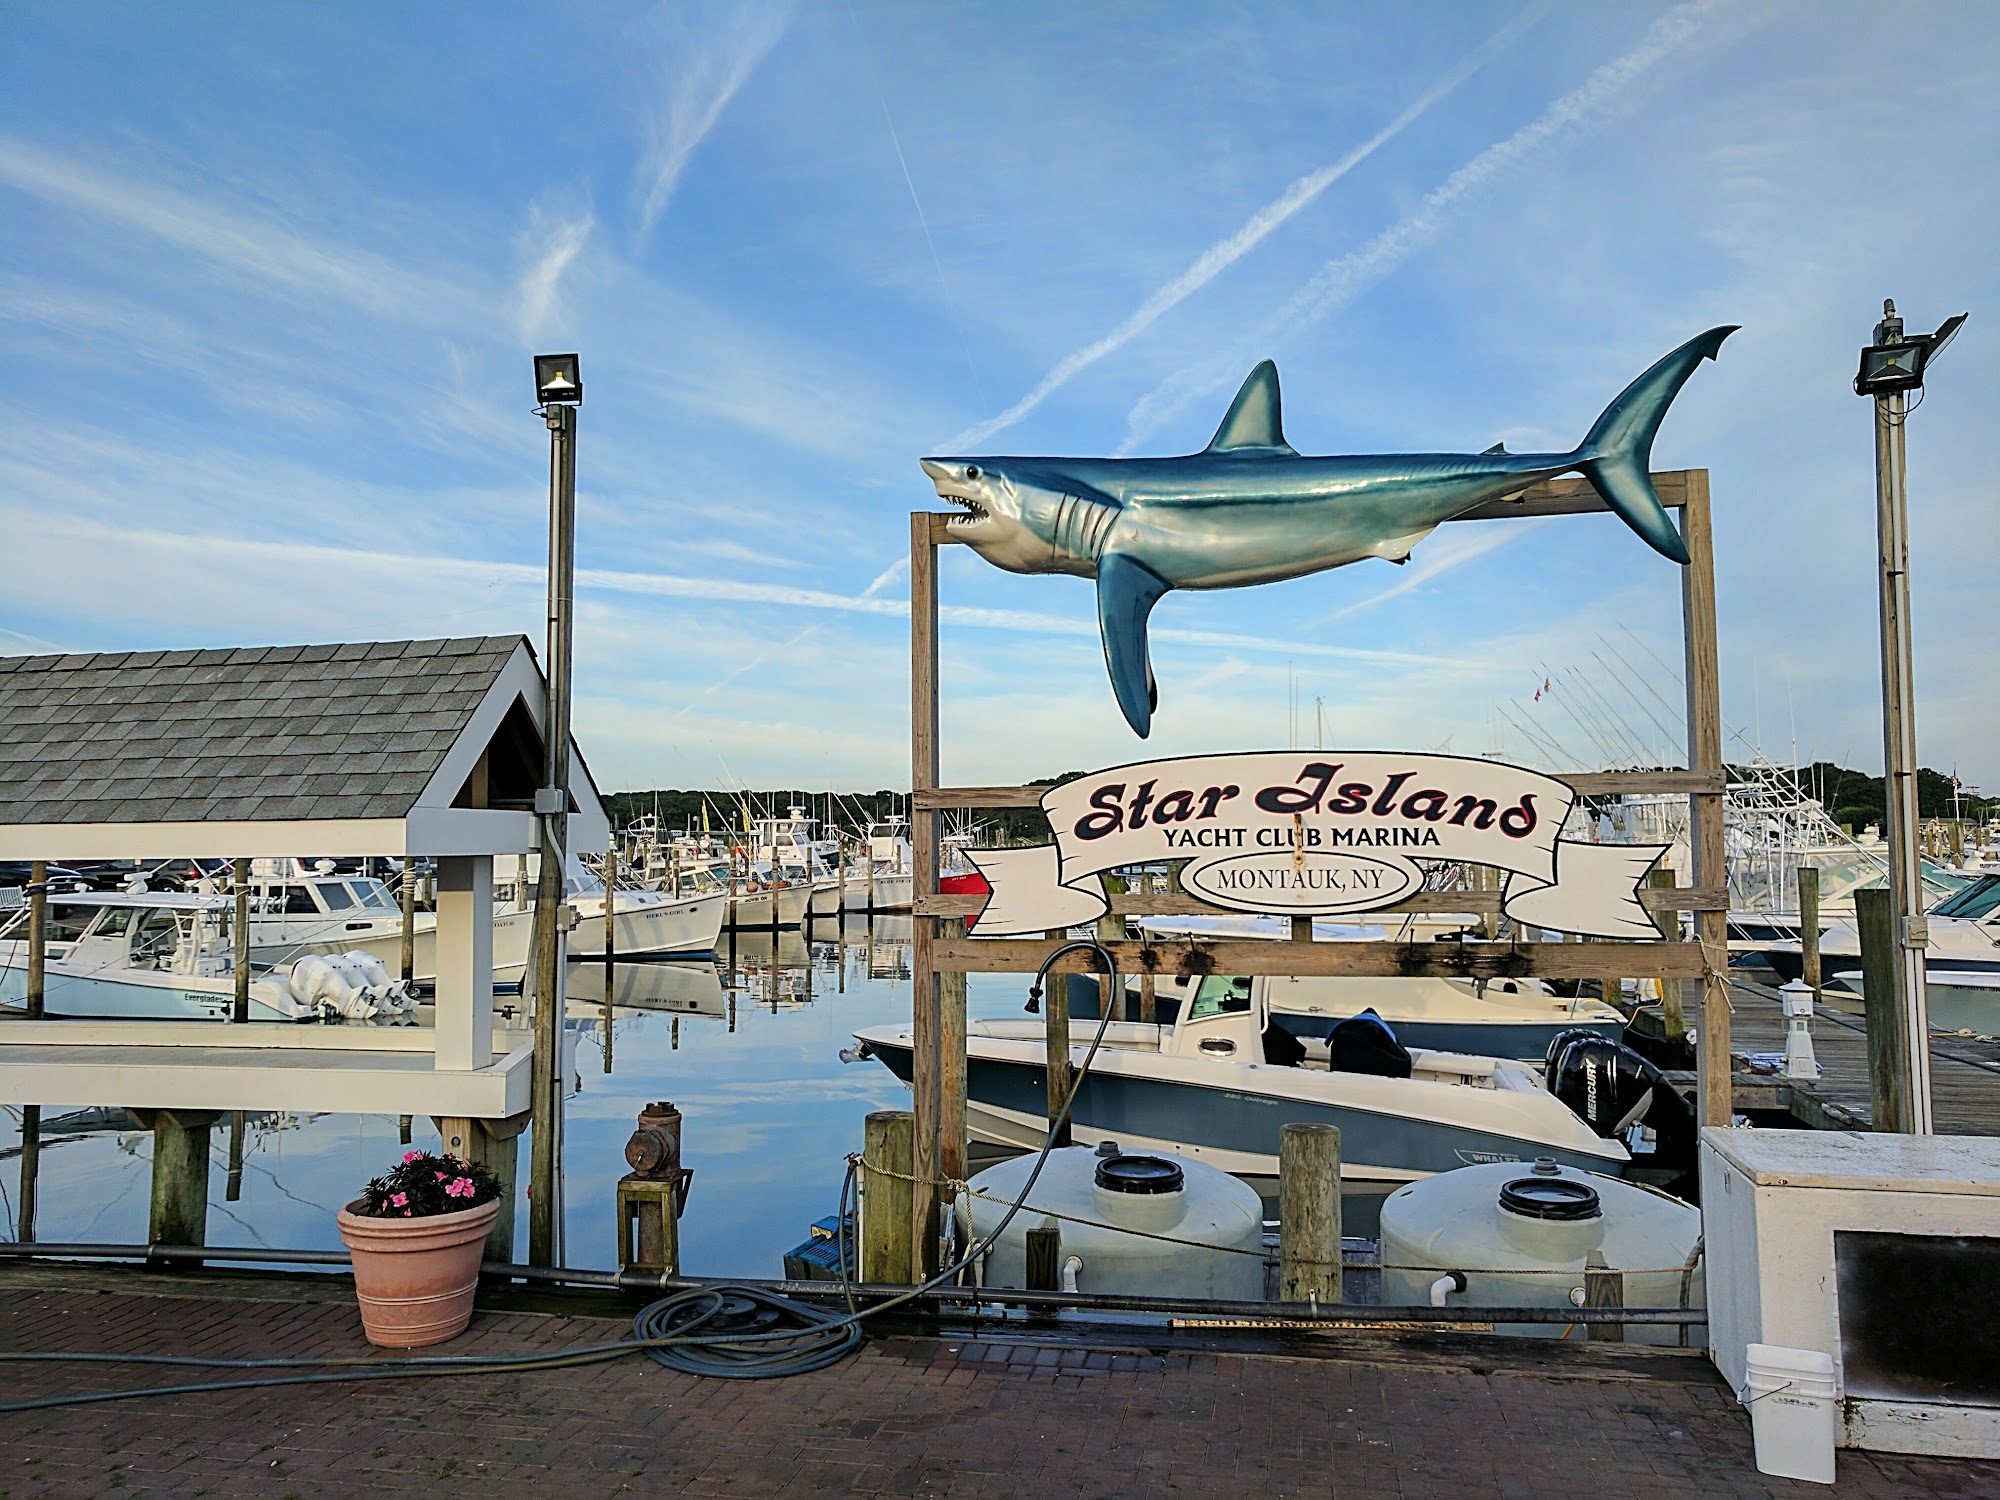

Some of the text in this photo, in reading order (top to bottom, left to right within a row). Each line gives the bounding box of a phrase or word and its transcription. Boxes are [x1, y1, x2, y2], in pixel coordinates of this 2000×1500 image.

[1073, 762, 1538, 841] Star Island
[1162, 828, 1442, 848] YACHT CLUB MARINA
[1217, 868, 1385, 893] MONTAUK, NY
[184, 993, 224, 1003] Everglades
[1244, 1095, 1279, 1106] Outrage
[1585, 1058, 1597, 1122] MERCURY
